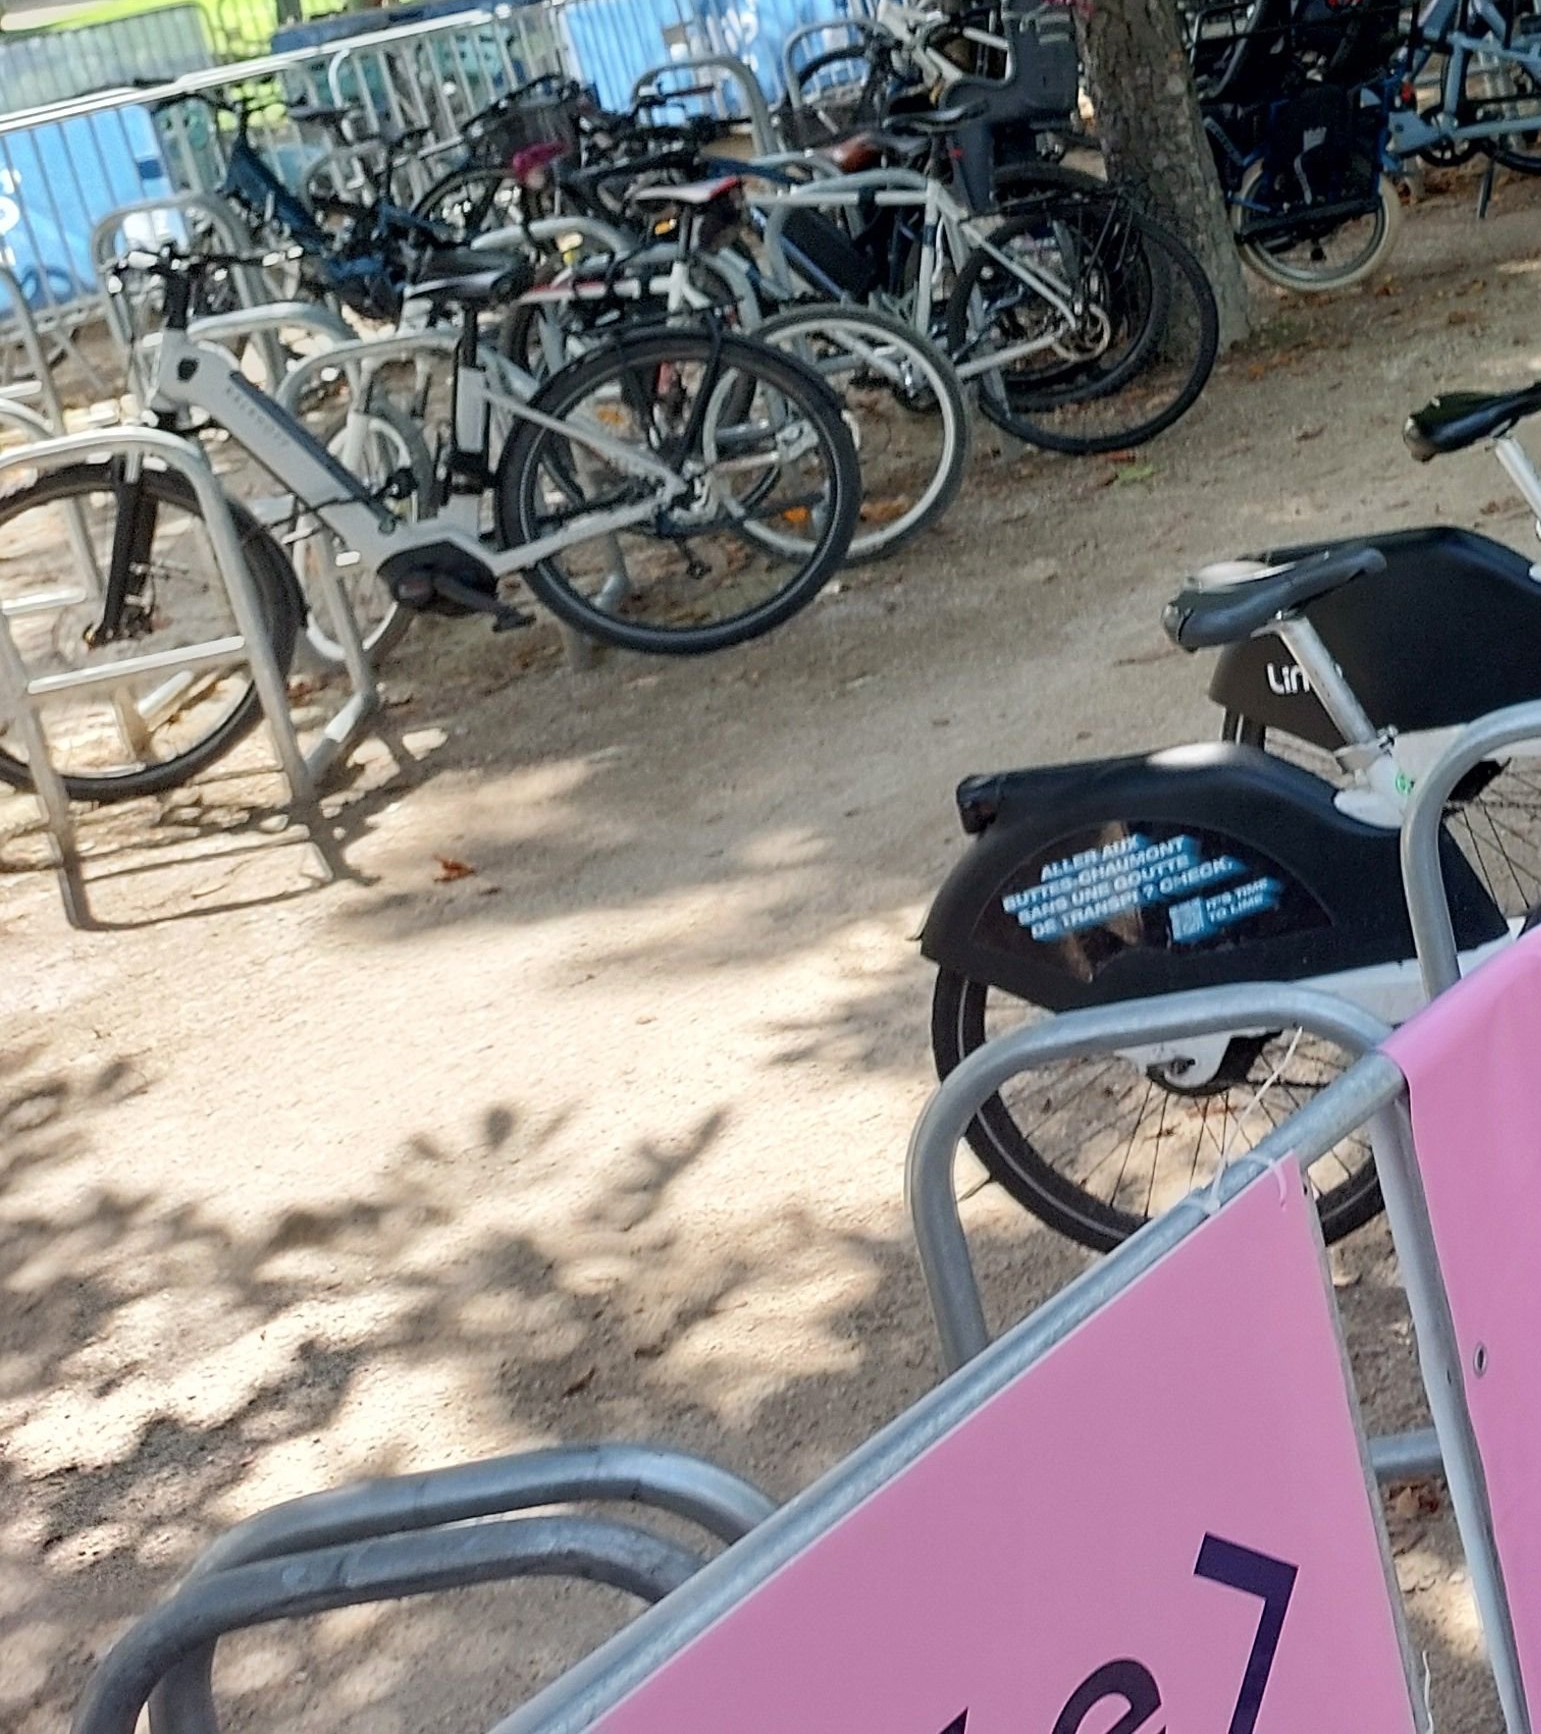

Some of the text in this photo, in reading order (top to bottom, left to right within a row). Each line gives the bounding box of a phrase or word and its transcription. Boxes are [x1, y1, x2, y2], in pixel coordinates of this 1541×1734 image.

[1002, 834, 1185, 912] BUTTES-CHAUMONT
[1041, 833, 1138, 883] ALLER AUX
[1017, 855, 1190, 926] SANS UNE GOUTTE
[1031, 917, 1057, 940] DE
